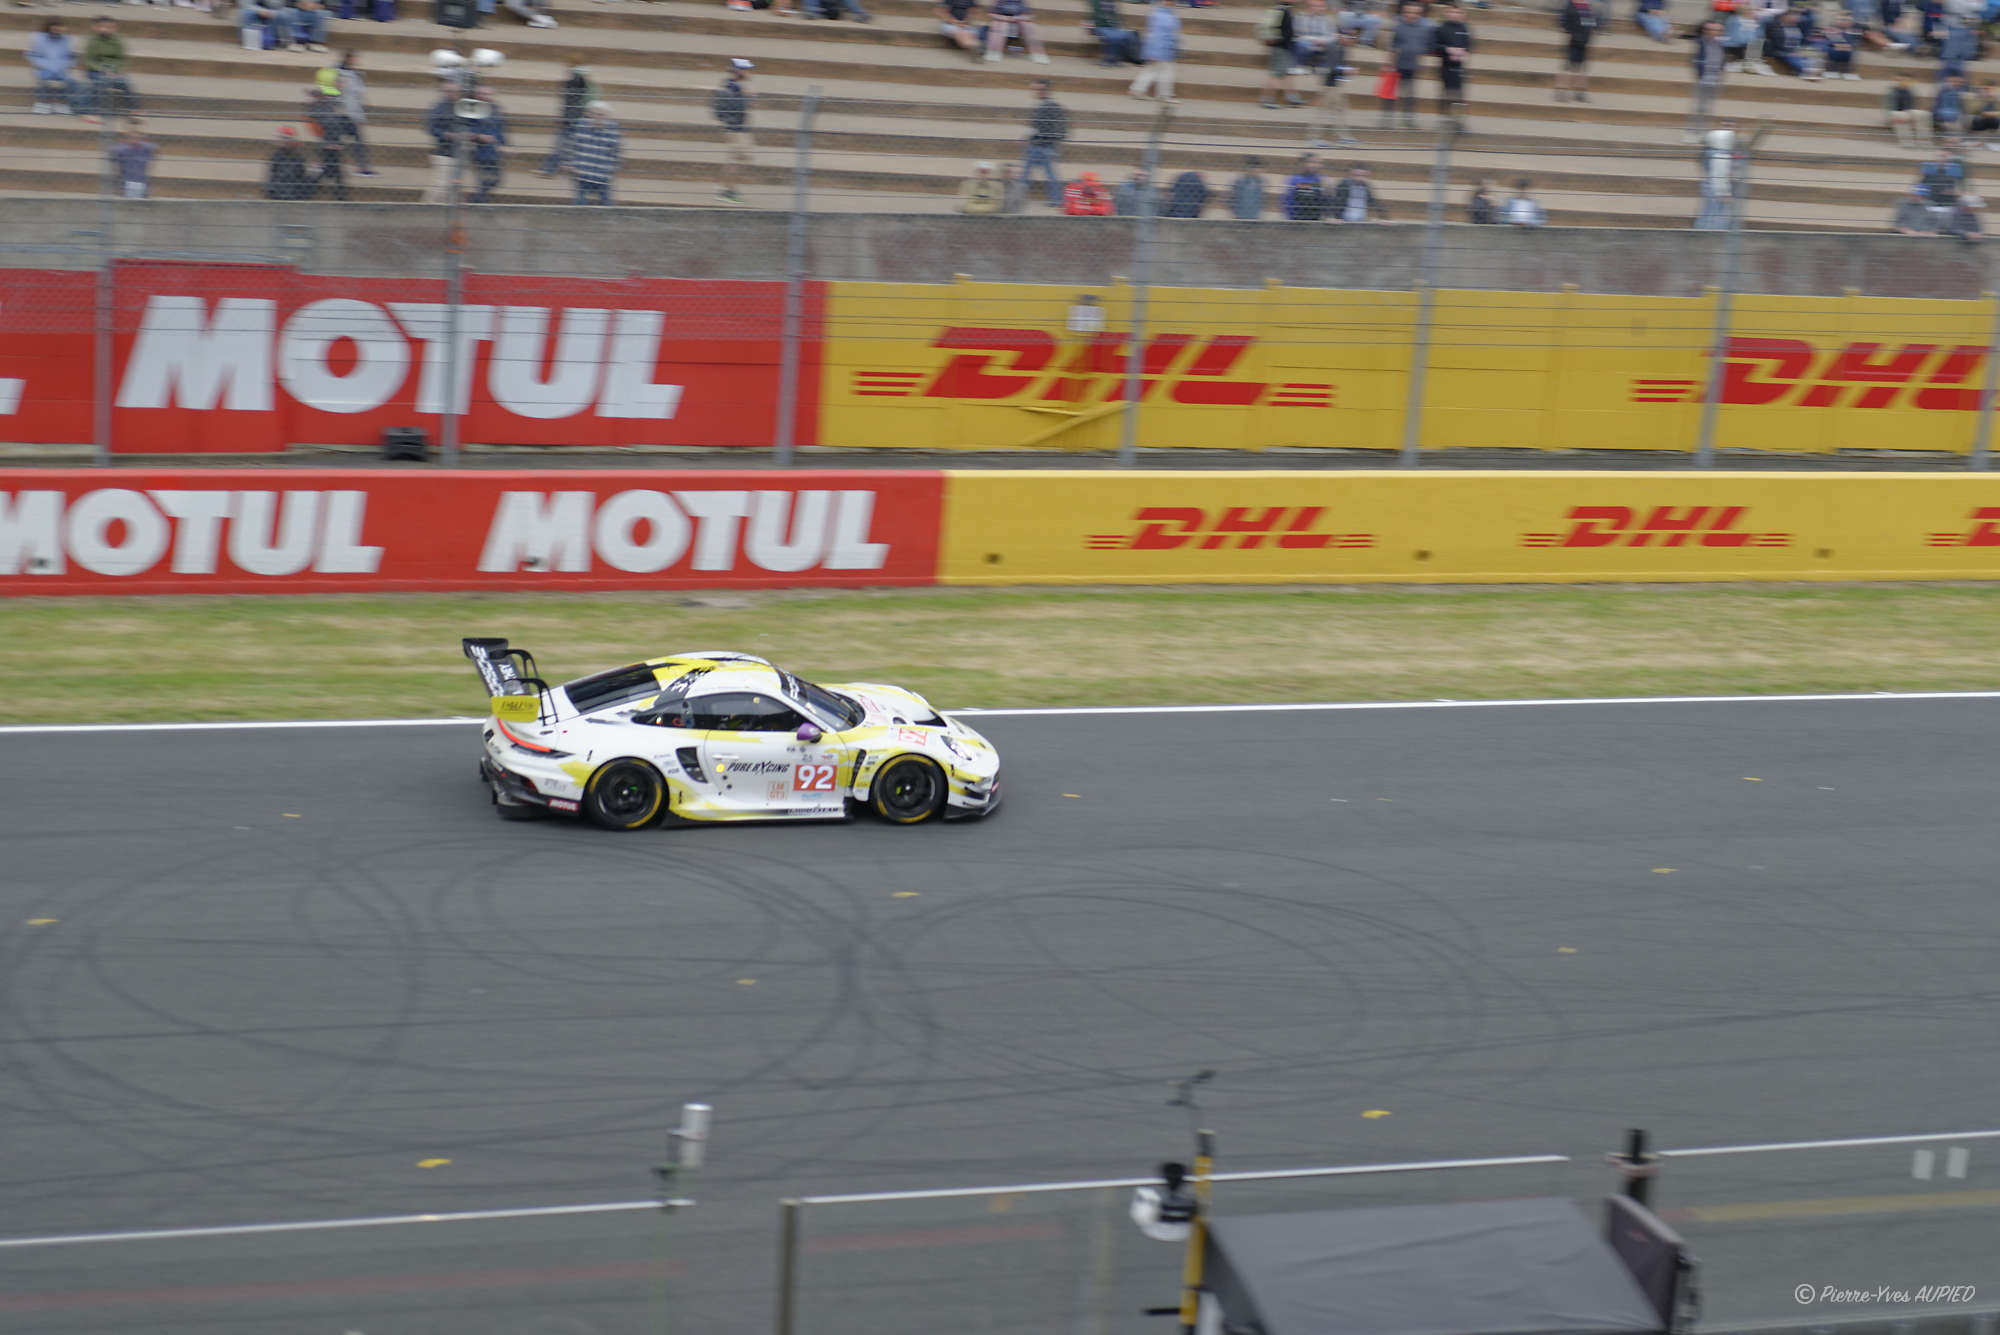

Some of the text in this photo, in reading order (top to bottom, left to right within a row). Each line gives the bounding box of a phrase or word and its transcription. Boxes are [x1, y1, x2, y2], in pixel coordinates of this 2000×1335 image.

[115, 295, 685, 420] MOTUL
[922, 326, 1270, 406] DHL
[1696, 336, 1994, 411] DHL
[0, 488, 385, 576] MOTUL
[477, 489, 890, 575] MOTUL
[1127, 506, 1331, 550] DHL
[1562, 505, 1753, 548] DHL
[798, 765, 834, 789] 92
